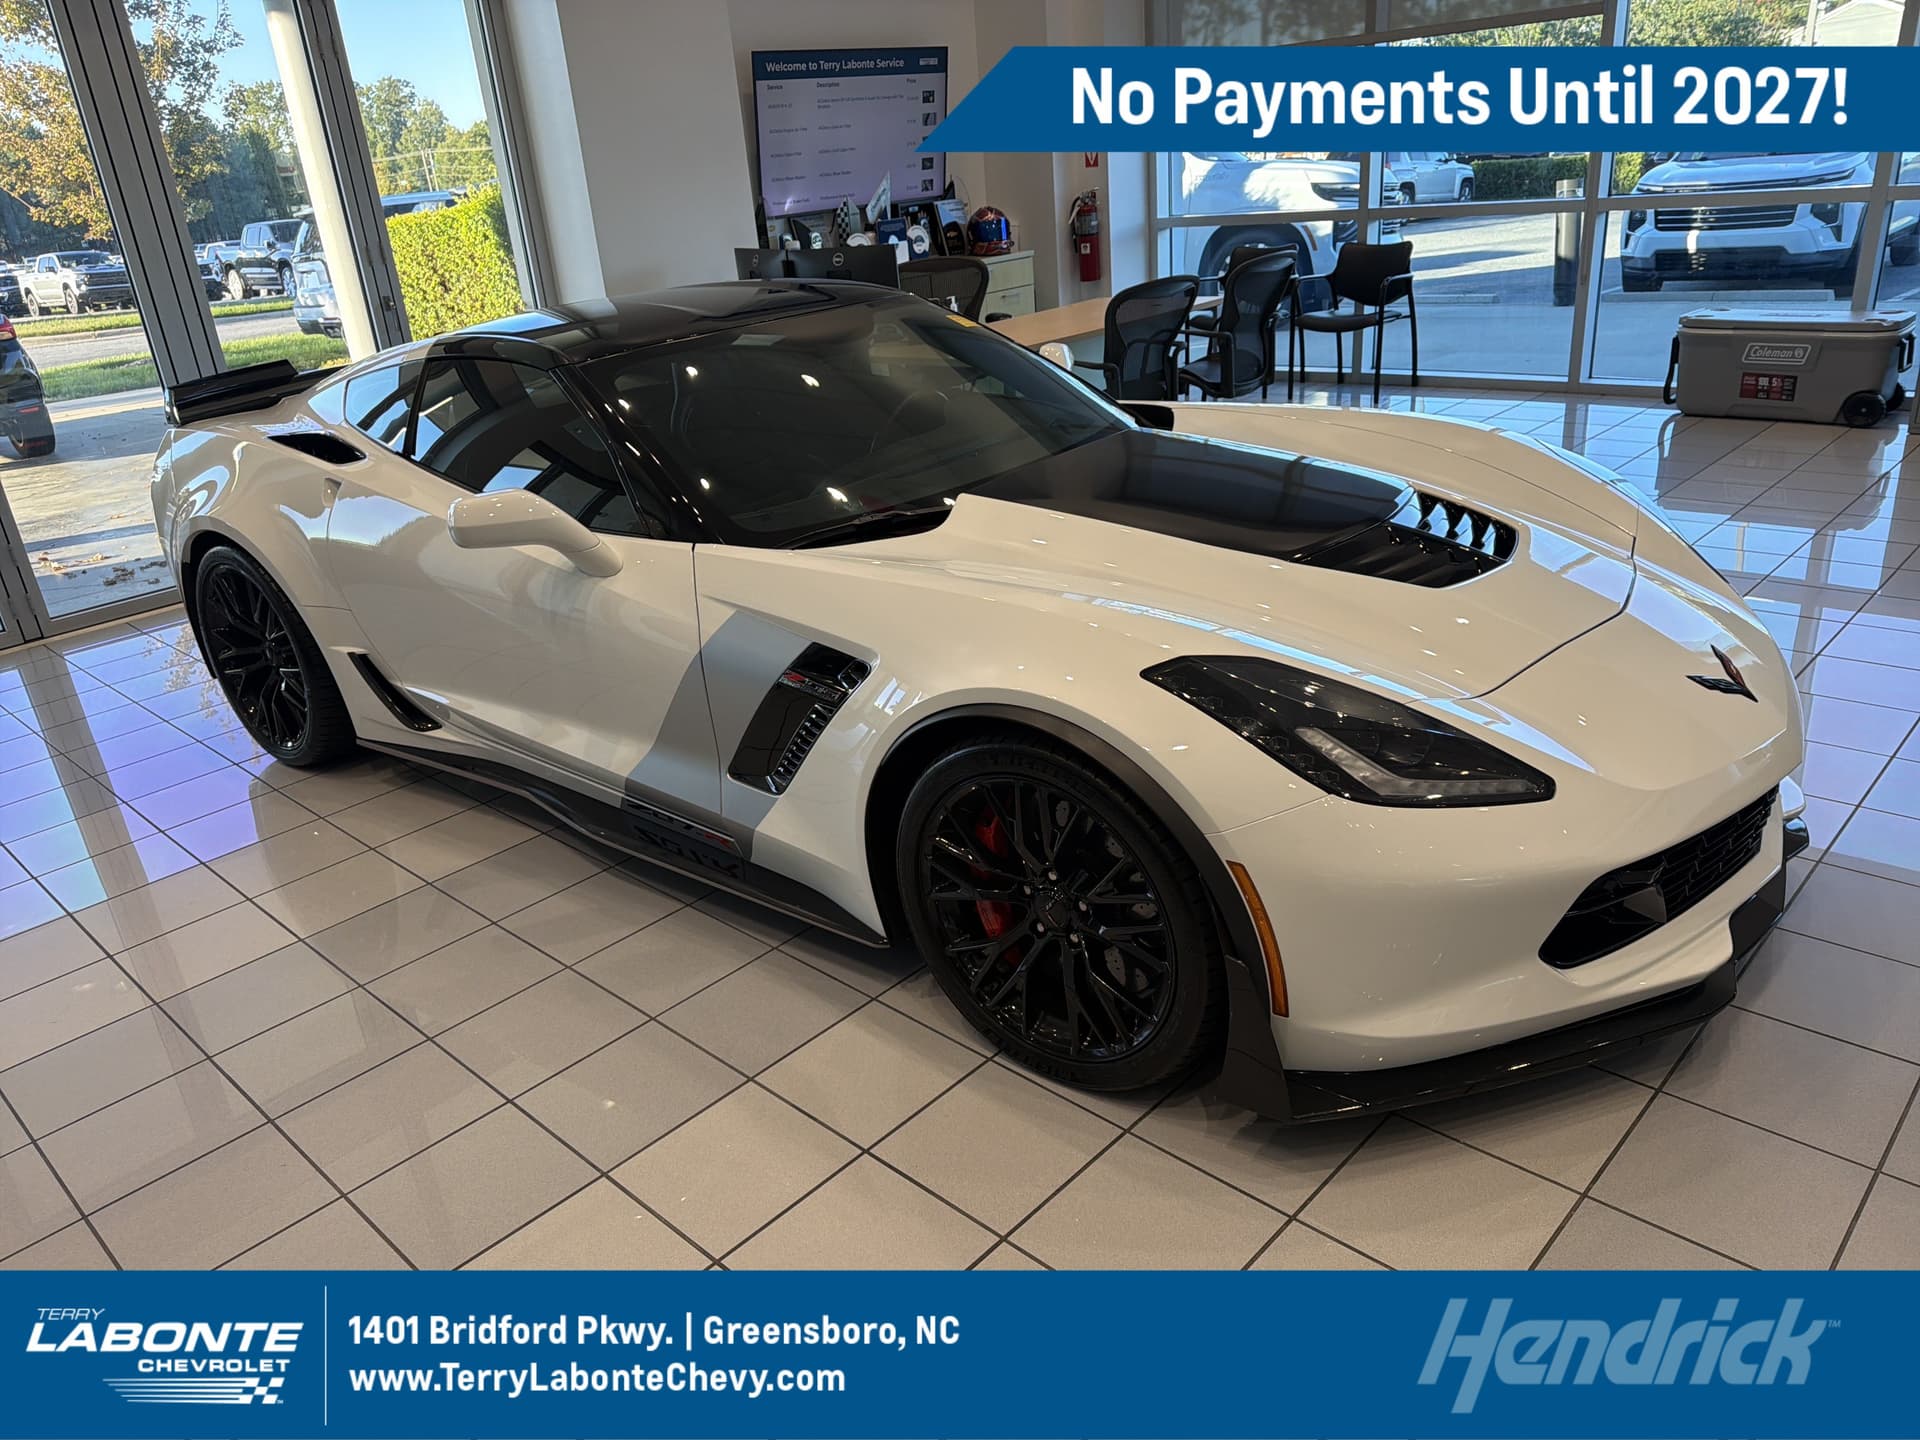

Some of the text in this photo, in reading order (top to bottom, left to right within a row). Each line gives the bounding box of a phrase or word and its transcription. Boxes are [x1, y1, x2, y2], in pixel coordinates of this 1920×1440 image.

[765, 61, 806, 73] Welcome
[808, 61, 818, 71] to
[819, 59, 840, 72] Terry
[842, 58, 875, 70] Labonte
[876, 57, 905, 69] Service
[1750, 346, 1793, 358] Coleman
